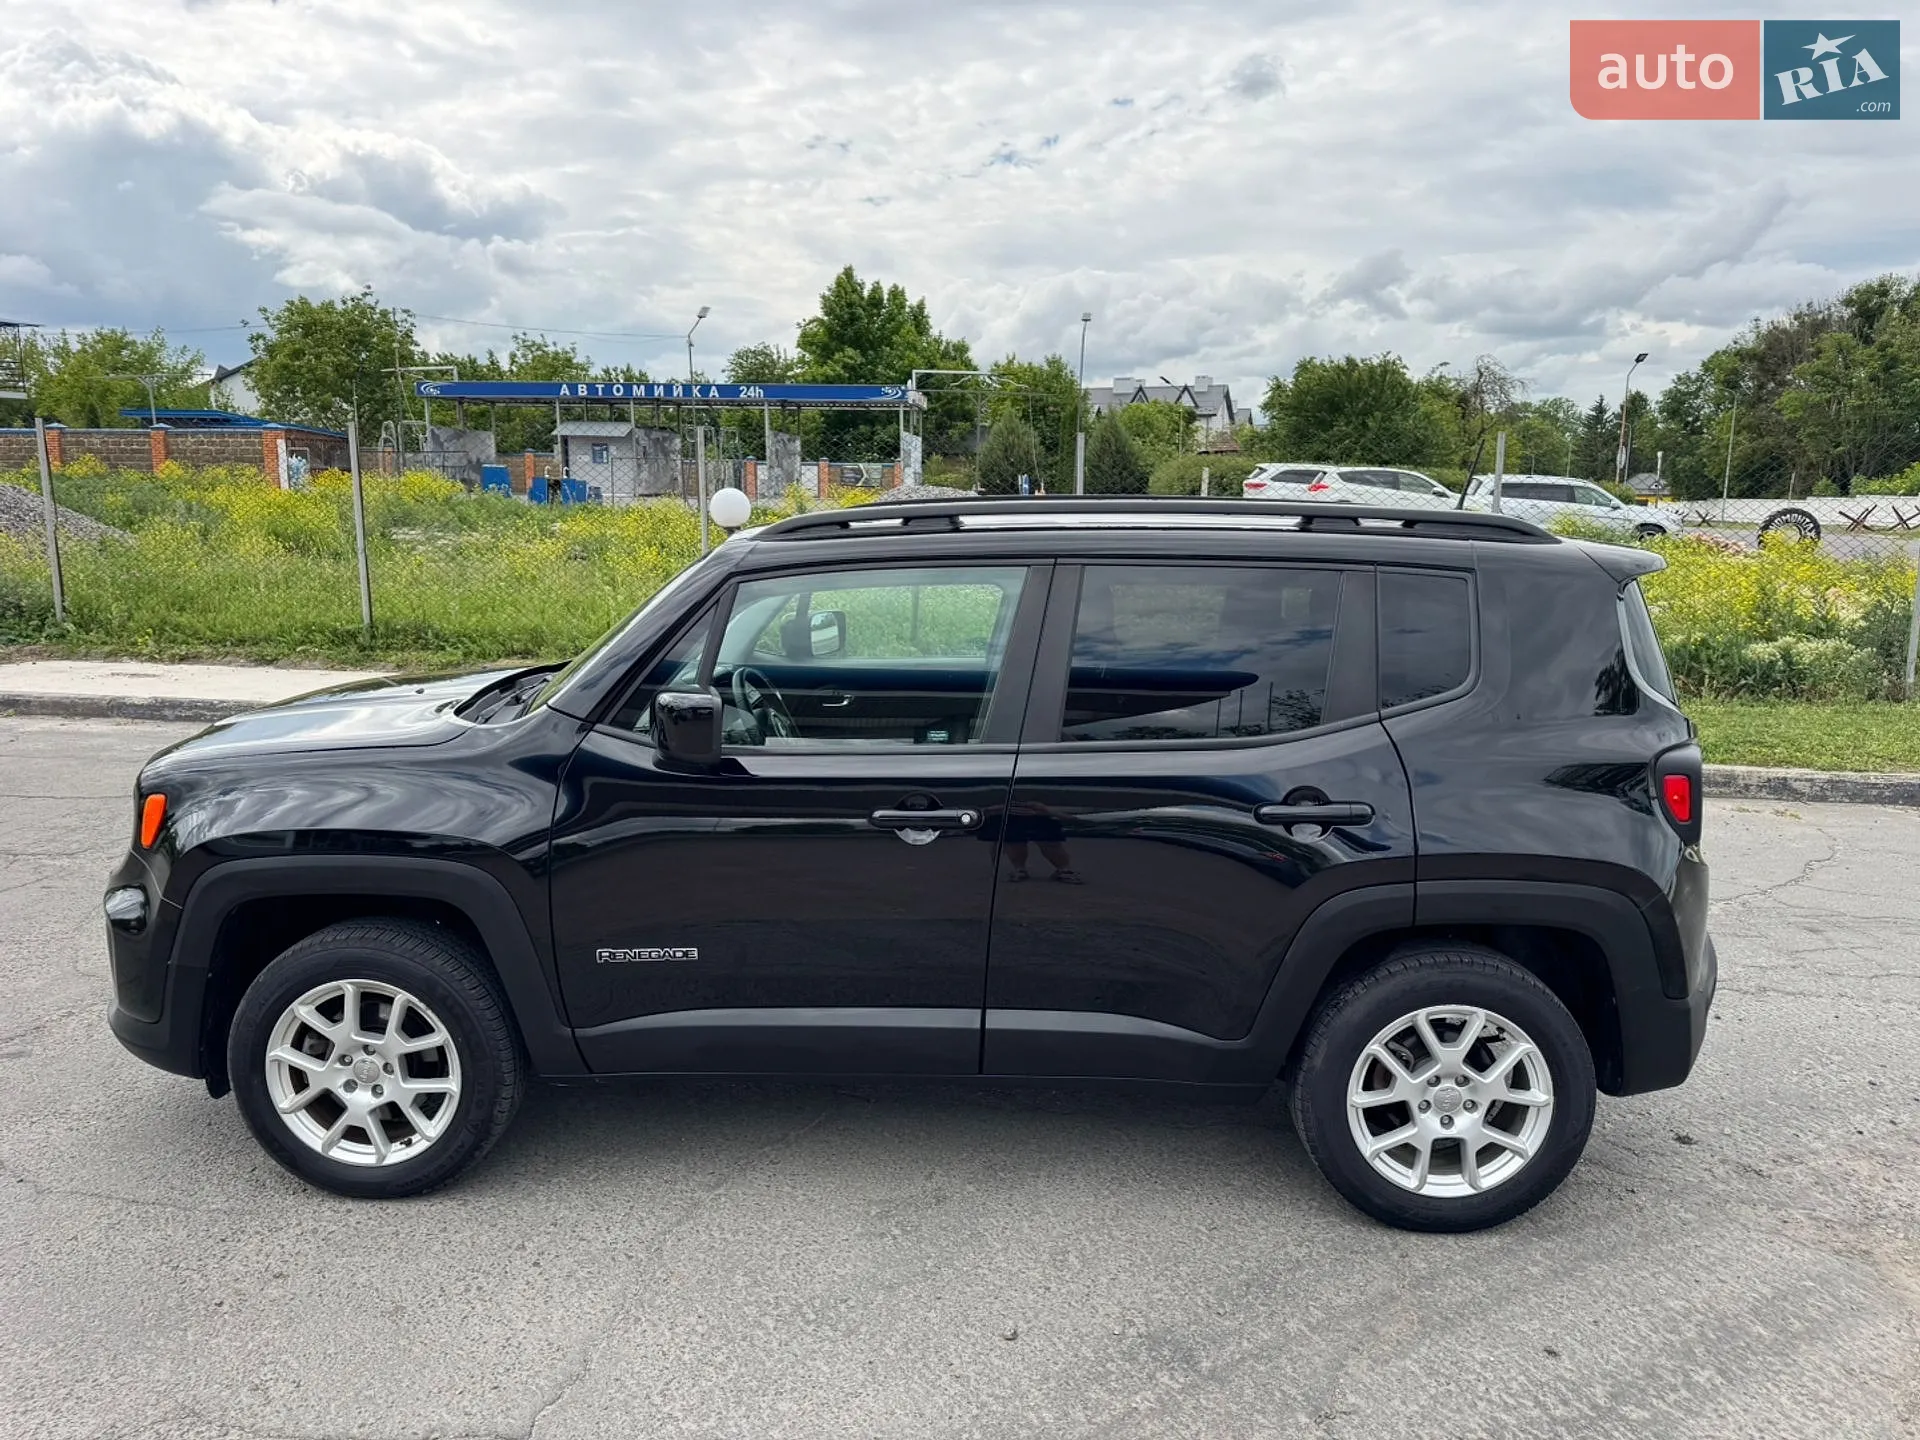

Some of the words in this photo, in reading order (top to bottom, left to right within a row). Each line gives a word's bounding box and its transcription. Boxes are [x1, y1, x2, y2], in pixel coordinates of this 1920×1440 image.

[559, 383, 719, 398] АВТОМИЙКА
[739, 386, 764, 399] 24h
[596, 948, 699, 963] RENEGADE
